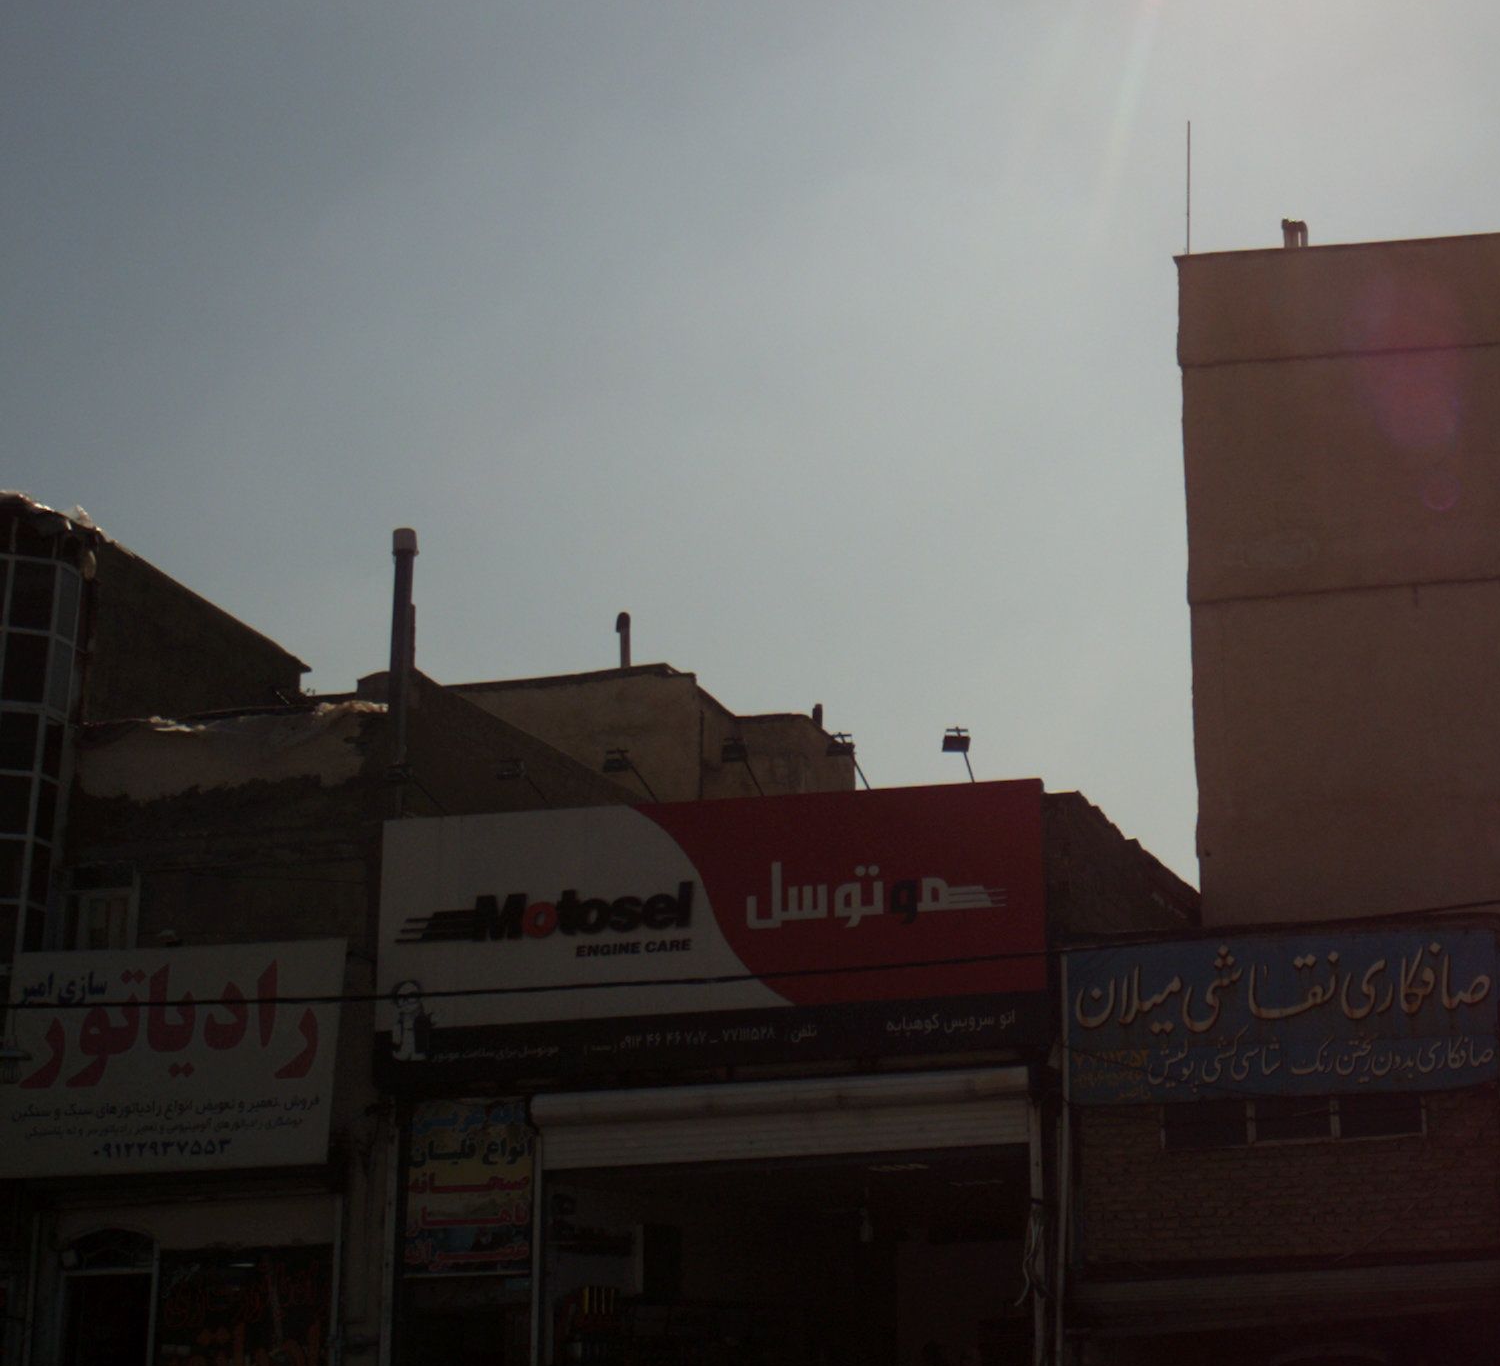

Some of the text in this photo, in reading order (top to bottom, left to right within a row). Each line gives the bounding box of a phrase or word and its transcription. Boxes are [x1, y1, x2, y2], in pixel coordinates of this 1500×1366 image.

[465, 881, 695, 943] Motosel
[746, 861, 985, 929] موتوسل
[575, 938, 692, 958] ENGINE CARE
[58, 971, 108, 1005] سازی
[1075, 942, 1492, 1035] صافکاری نقاشی میلان
[18, 959, 319, 1089] رادیاتور
[885, 1009, 1017, 1036] اتو سرویس کوهپایه
[1202, 1024, 1250, 1084] کشی
[1230, 1035, 1282, 1082] شاسی
[1336, 1032, 1380, 1083] ریختن
[1371, 1049, 1417, 1079] بدون
[1417, 1035, 1495, 1074] صافکاری
[407, 1136, 534, 1169] انواع قلیان
[405, 1171, 530, 1197] صبحانه
